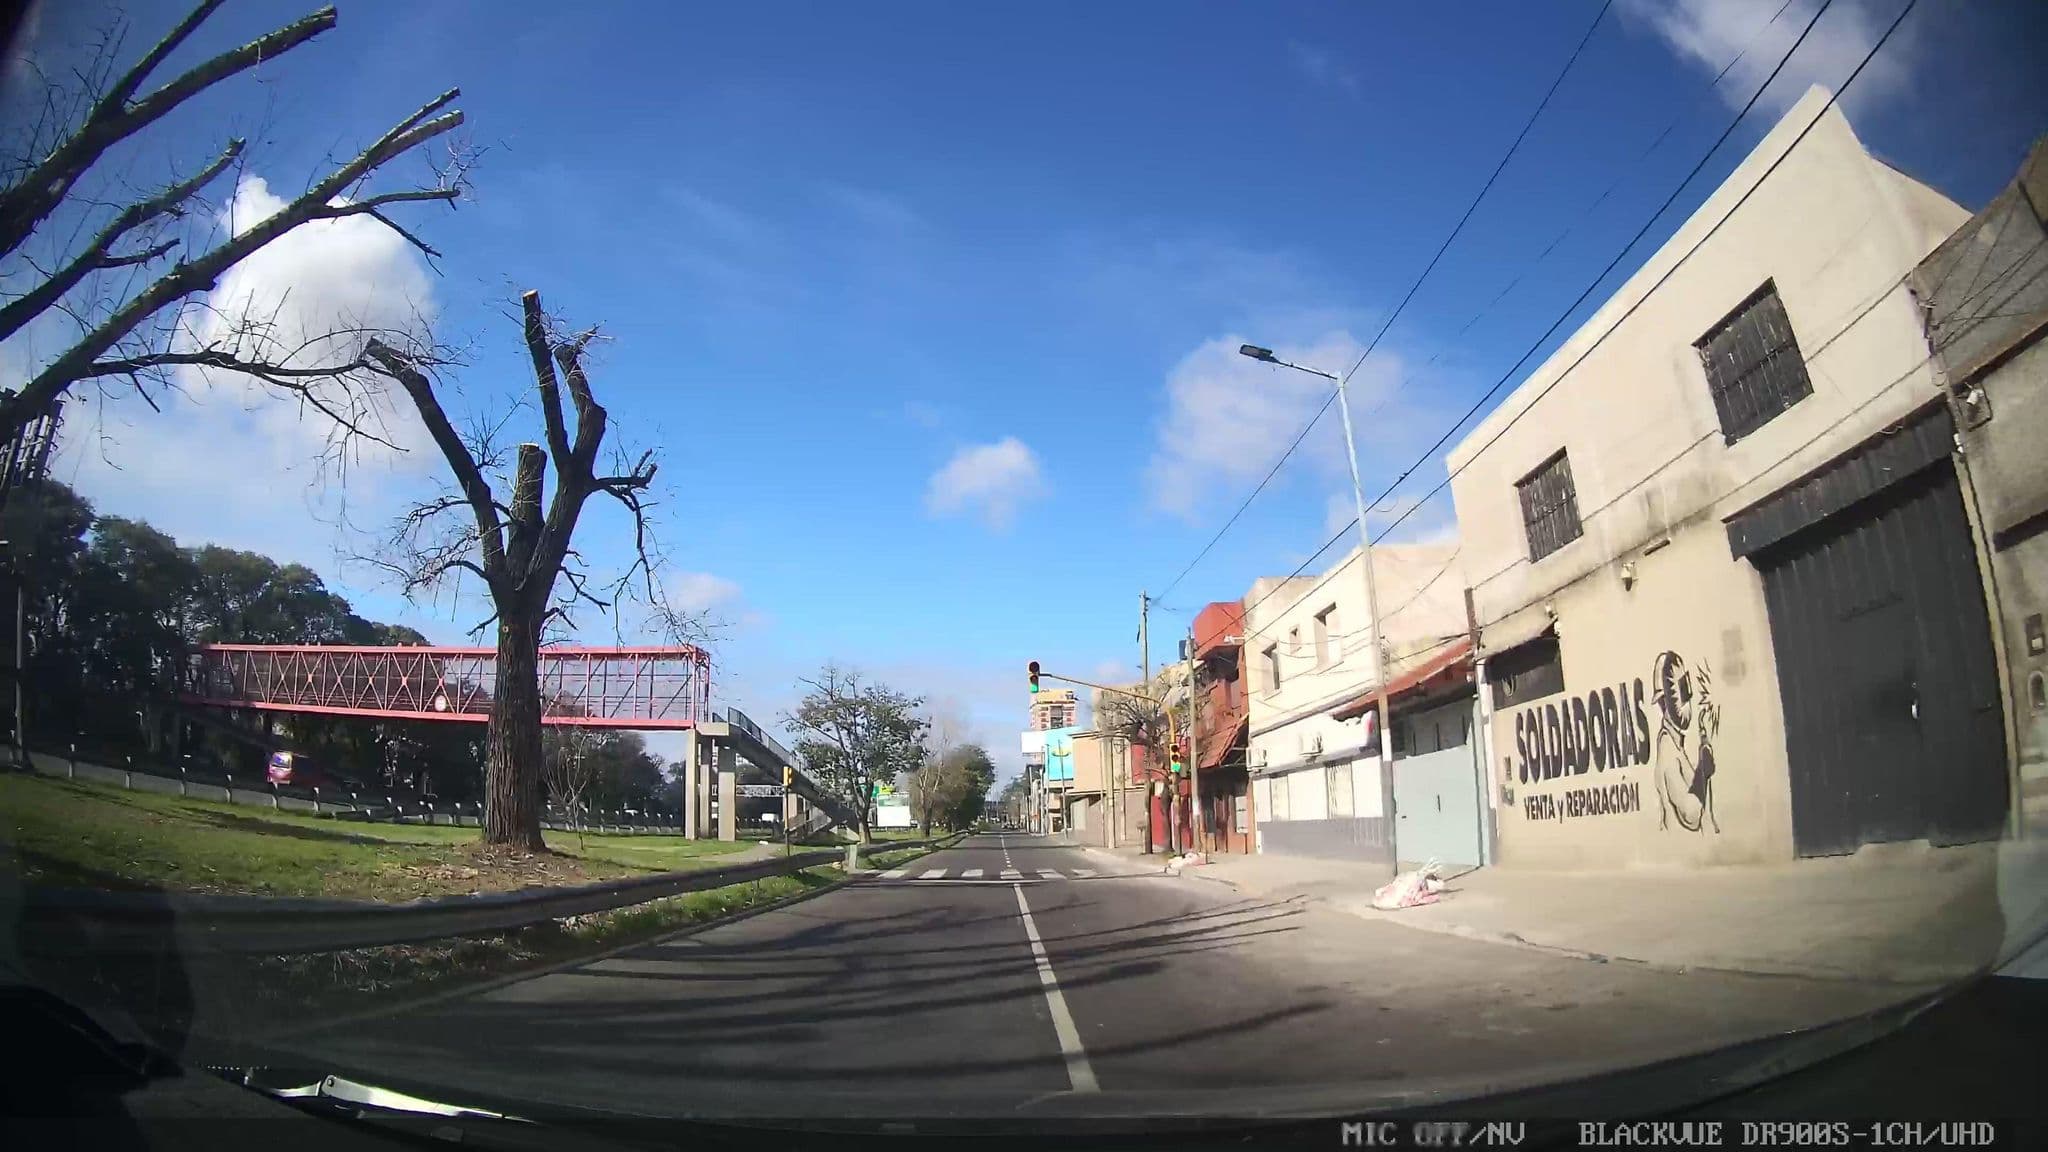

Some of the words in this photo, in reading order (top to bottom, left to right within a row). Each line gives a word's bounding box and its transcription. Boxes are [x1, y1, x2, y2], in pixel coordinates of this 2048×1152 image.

[1515, 677, 1651, 785] SOLDADORAS
[1524, 793, 1556, 821] VENTA
[1566, 776, 1640, 818] REPARACIÓN
